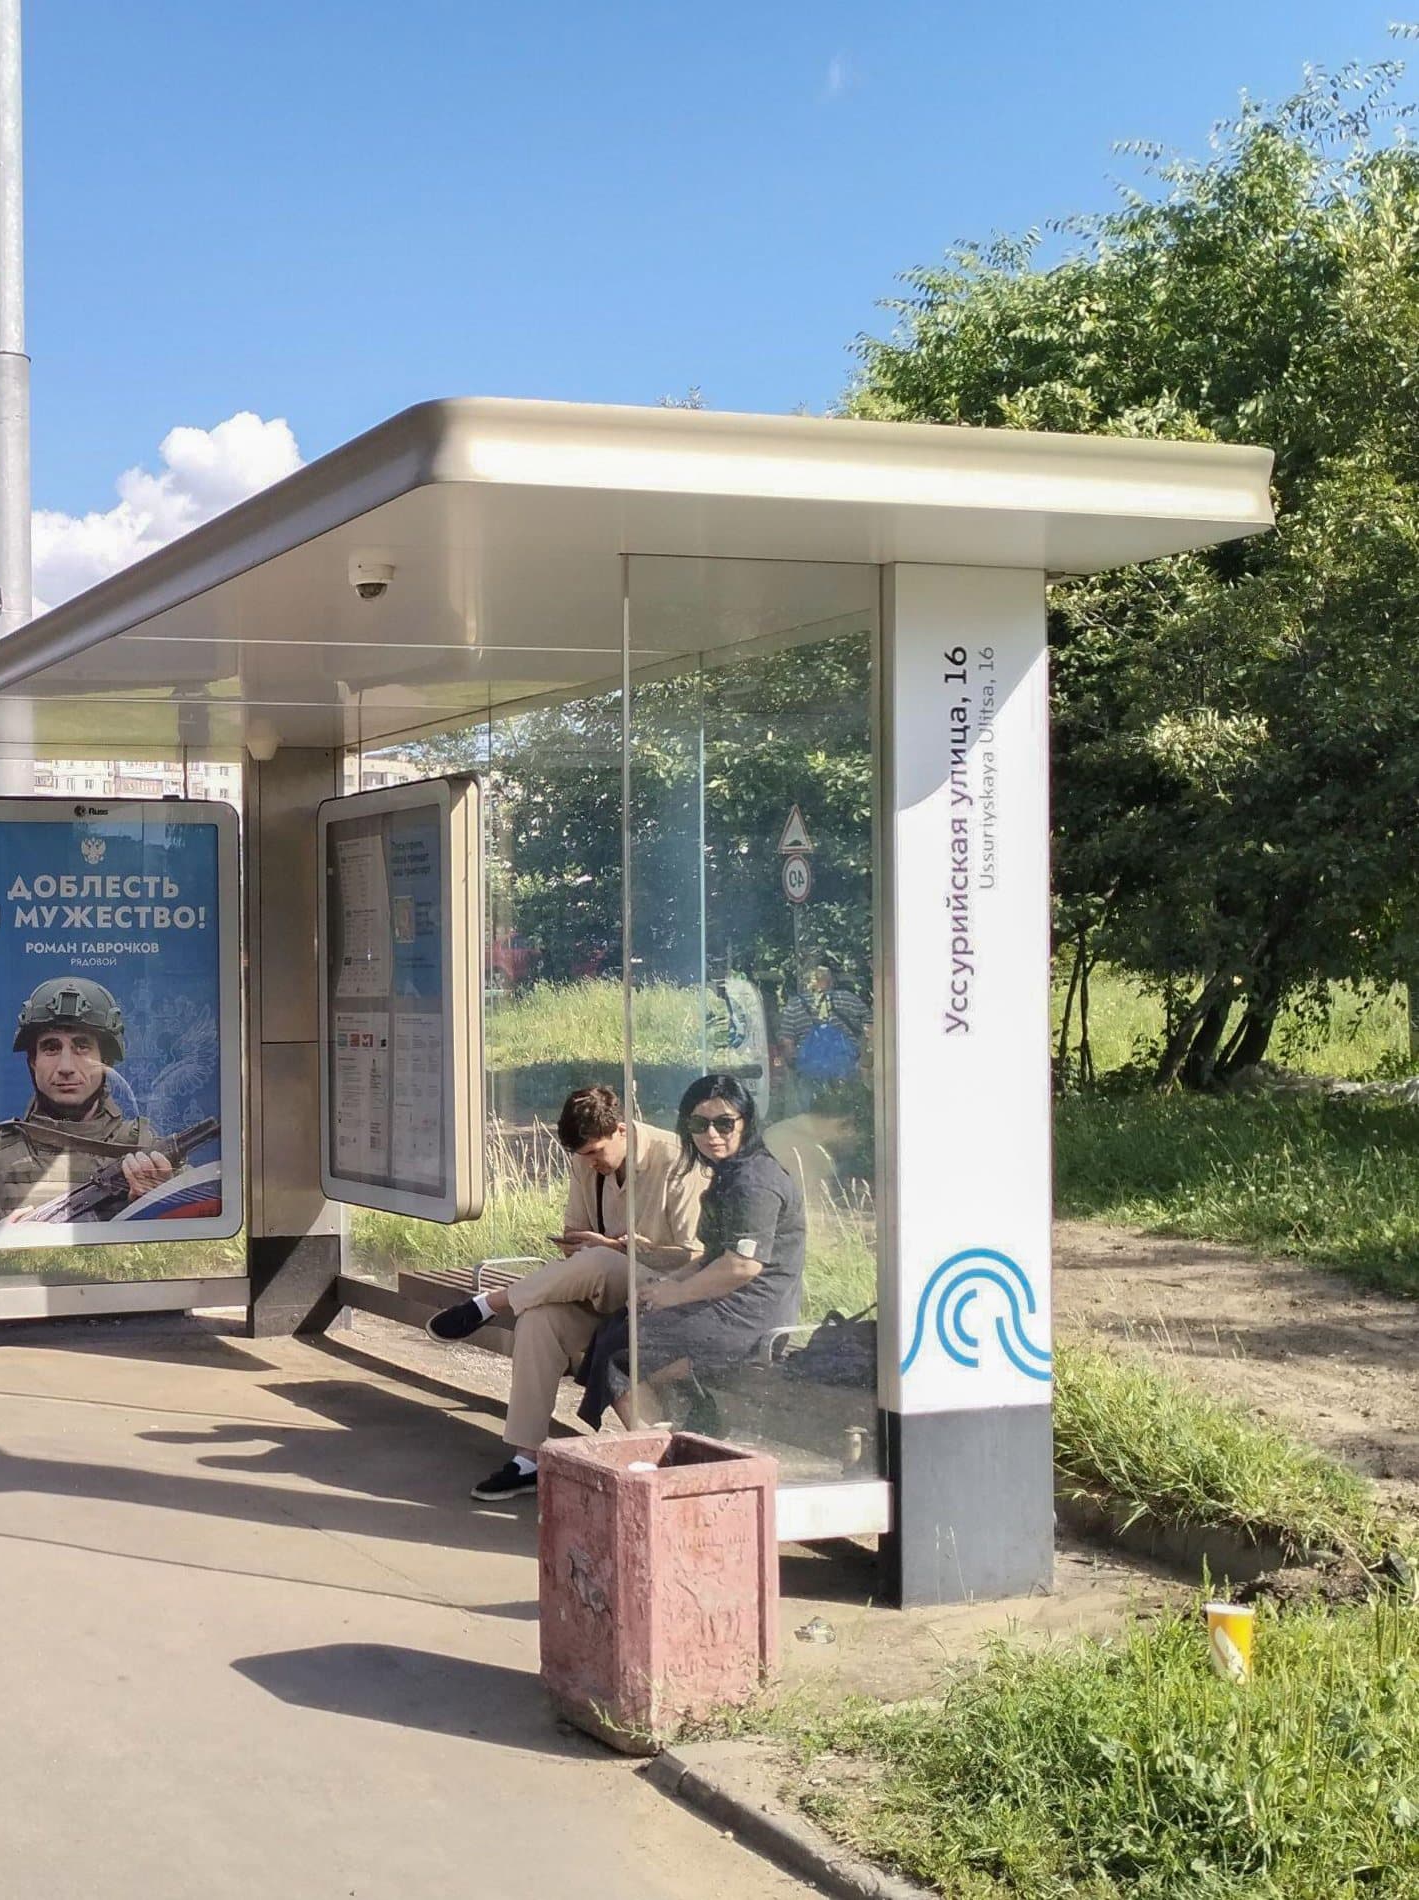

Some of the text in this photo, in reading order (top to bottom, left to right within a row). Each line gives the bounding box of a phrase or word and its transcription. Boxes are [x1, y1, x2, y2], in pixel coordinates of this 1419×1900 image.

[978, 647, 998, 890] Ussuriyskaya Ulitsa, 16
[943, 646, 975, 1035] Уссурийская улица, 16
[6, 874, 179, 901] ДОБЛЕСТЬ
[14, 905, 206, 930] МУЖЕСТВО!
[25, 942, 160, 954] РОМАН ГАВРОЧКОВ
[70, 956, 118, 967] РЯДОВОЙ
